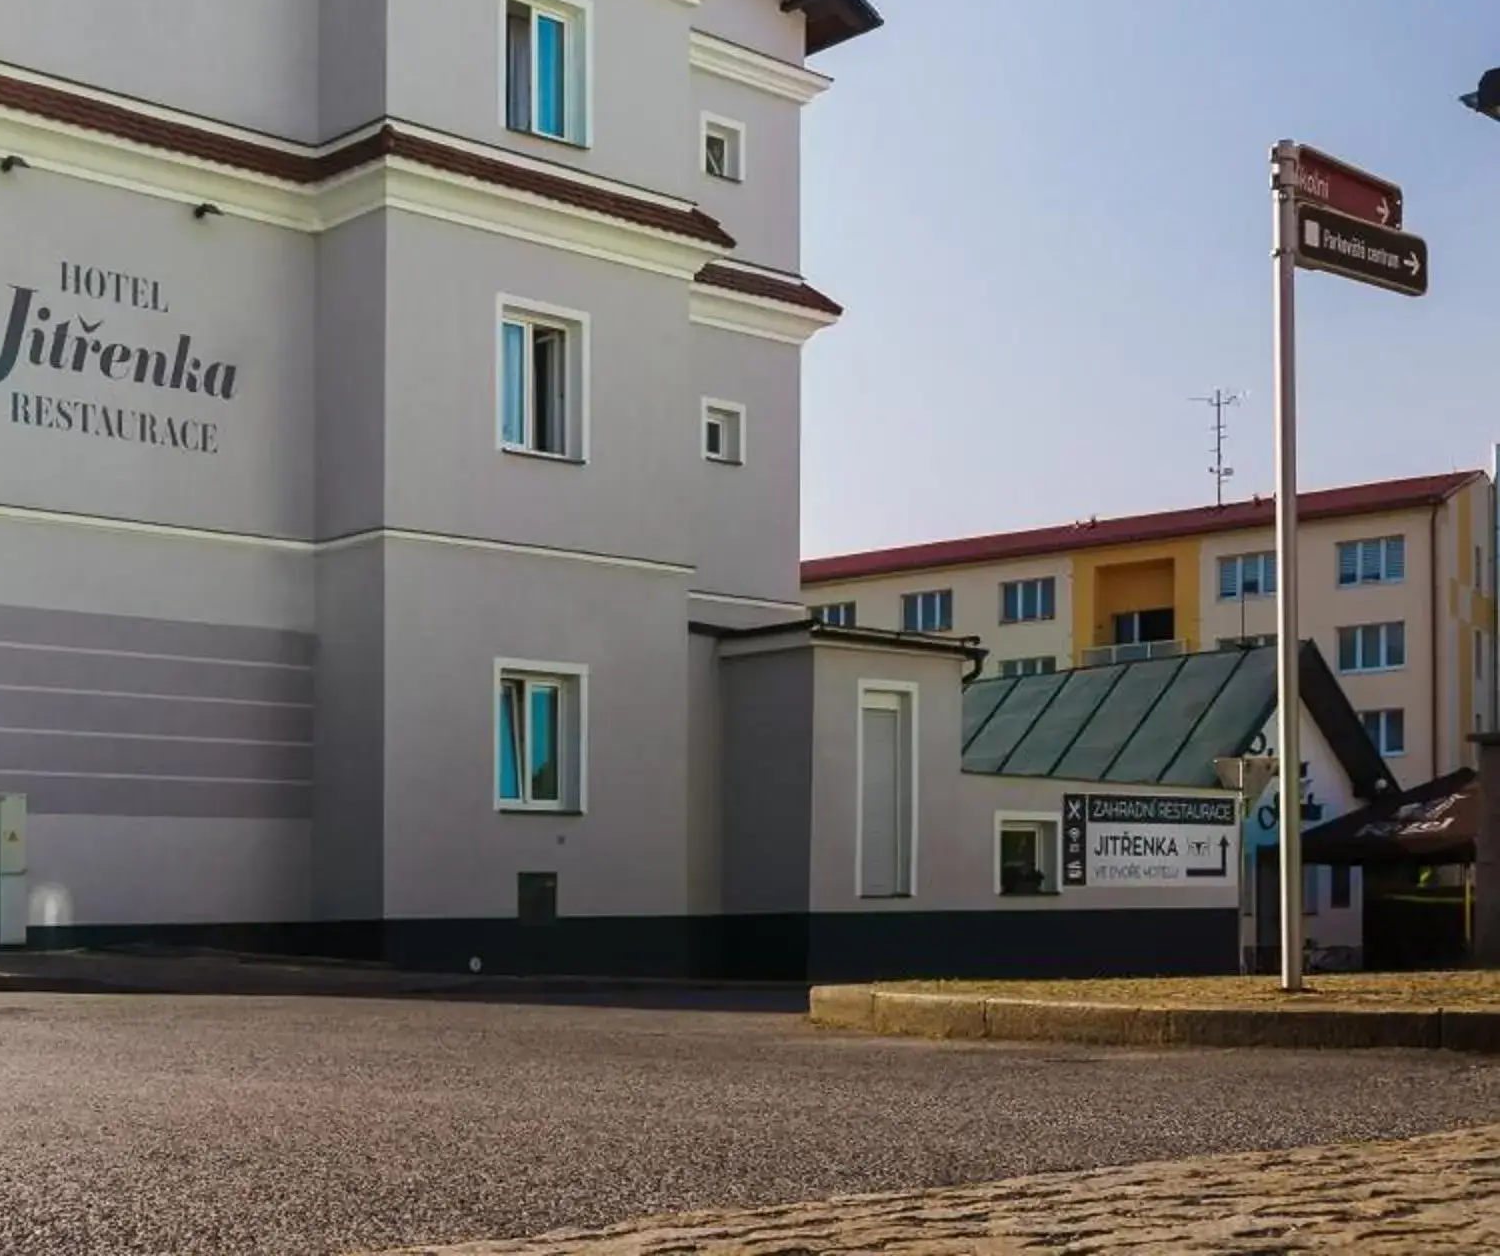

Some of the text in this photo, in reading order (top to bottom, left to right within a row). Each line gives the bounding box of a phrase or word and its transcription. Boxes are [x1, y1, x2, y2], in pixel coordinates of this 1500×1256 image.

[1367, 247, 1400, 270] centrum
[60, 261, 169, 313] HOTEL
[10, 391, 220, 454] RESTAURACE
[1093, 797, 1231, 821] ZAHRADNÍ RESTAURACE
[1094, 831, 1179, 857] JITŘENKA
